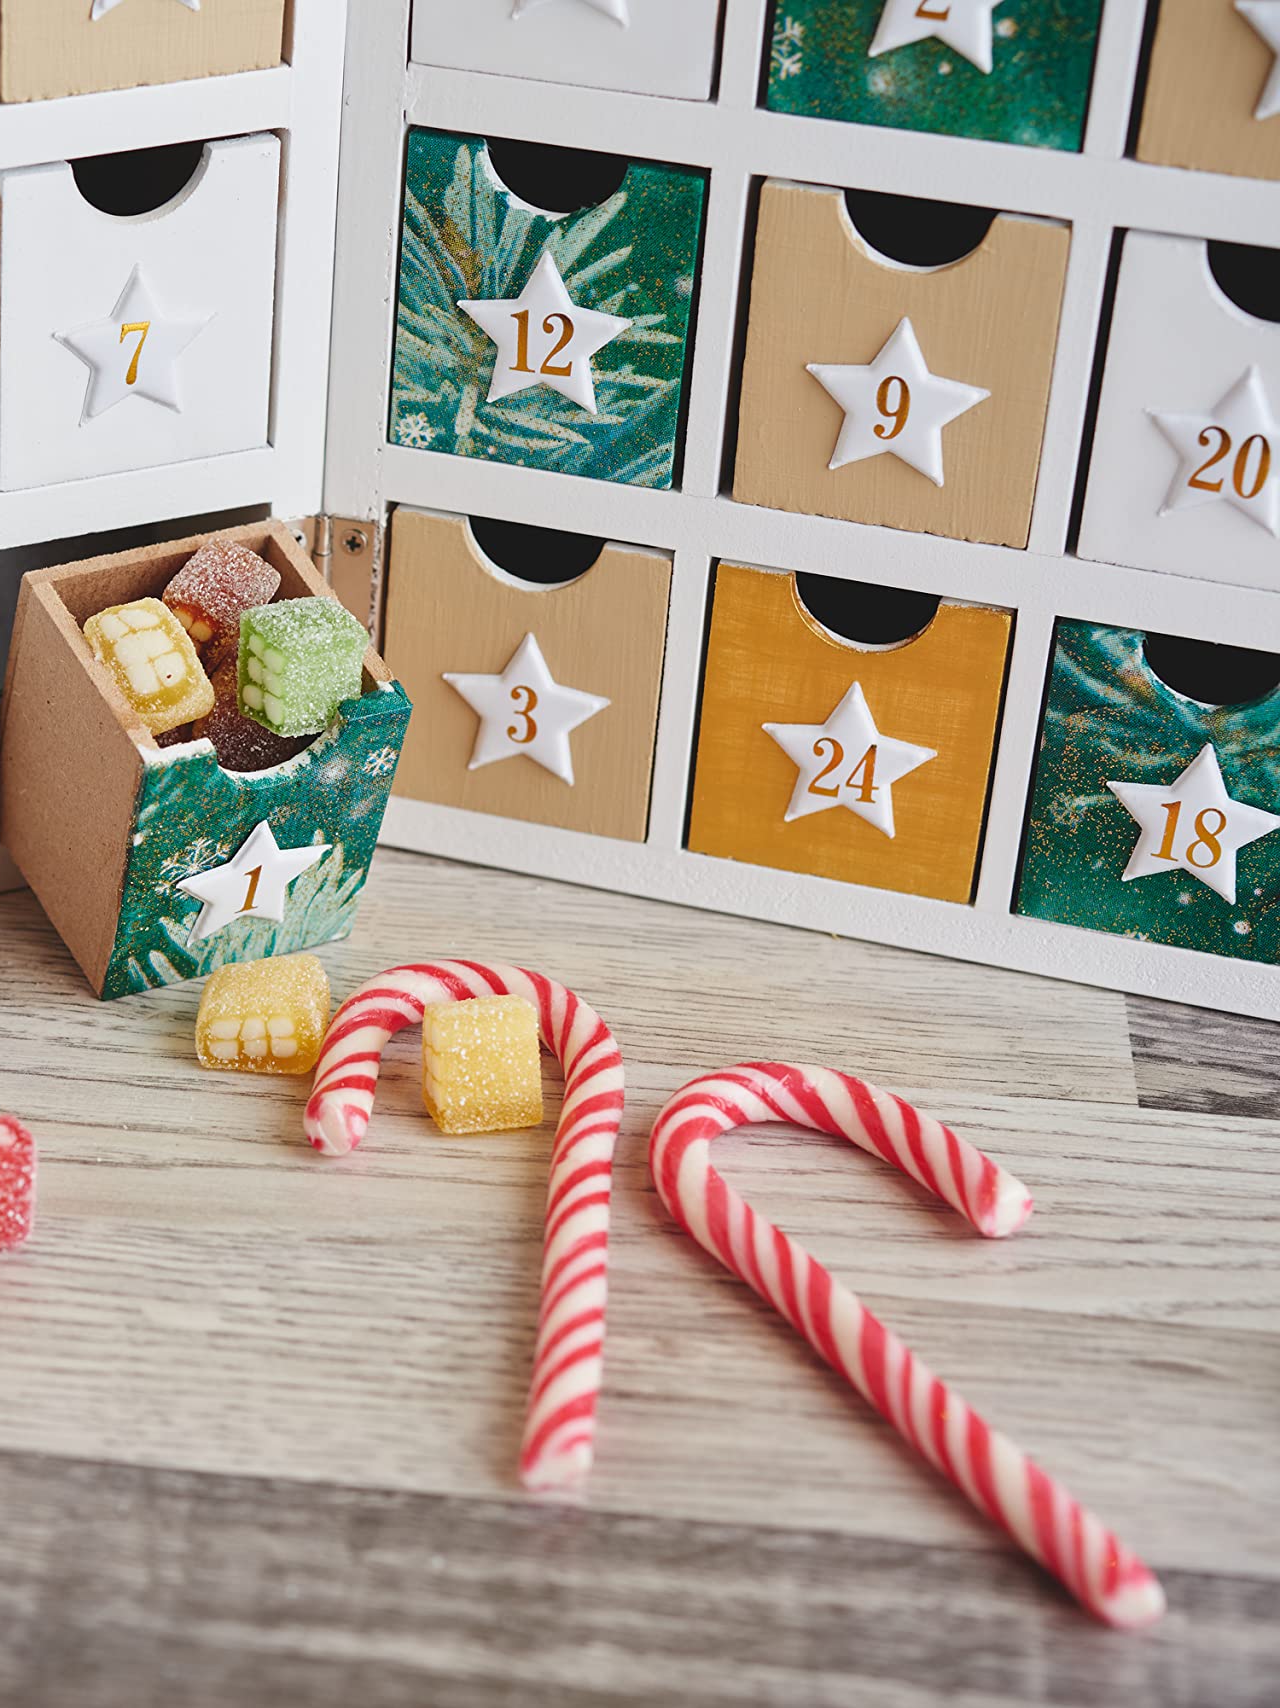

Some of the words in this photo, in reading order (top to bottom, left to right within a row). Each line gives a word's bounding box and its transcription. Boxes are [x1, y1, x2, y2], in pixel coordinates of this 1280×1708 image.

[119, 321, 150, 385] 7
[508, 310, 575, 376] 12
[873, 376, 911, 439] 9
[1188, 426, 1272, 500] 20
[506, 685, 538, 743] 3
[807, 737, 879, 804] 24
[1150, 801, 1227, 868] 18
[234, 866, 262, 913] 1
